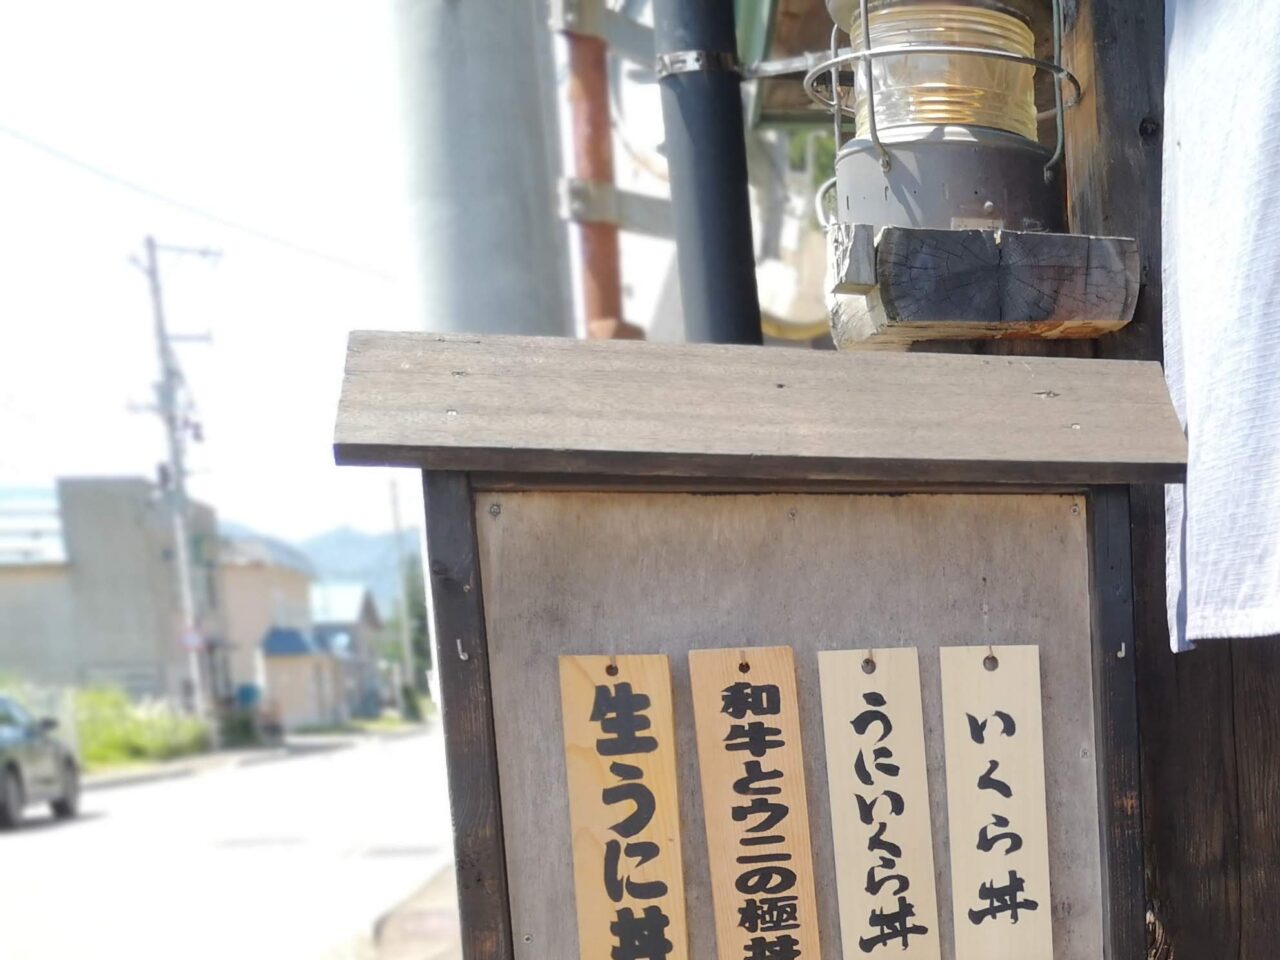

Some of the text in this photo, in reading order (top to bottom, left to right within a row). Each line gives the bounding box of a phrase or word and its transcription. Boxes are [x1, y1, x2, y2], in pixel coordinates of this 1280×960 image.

[850, 692, 928, 953] うにいくら丼
[966, 710, 1038, 925] いくら丼
